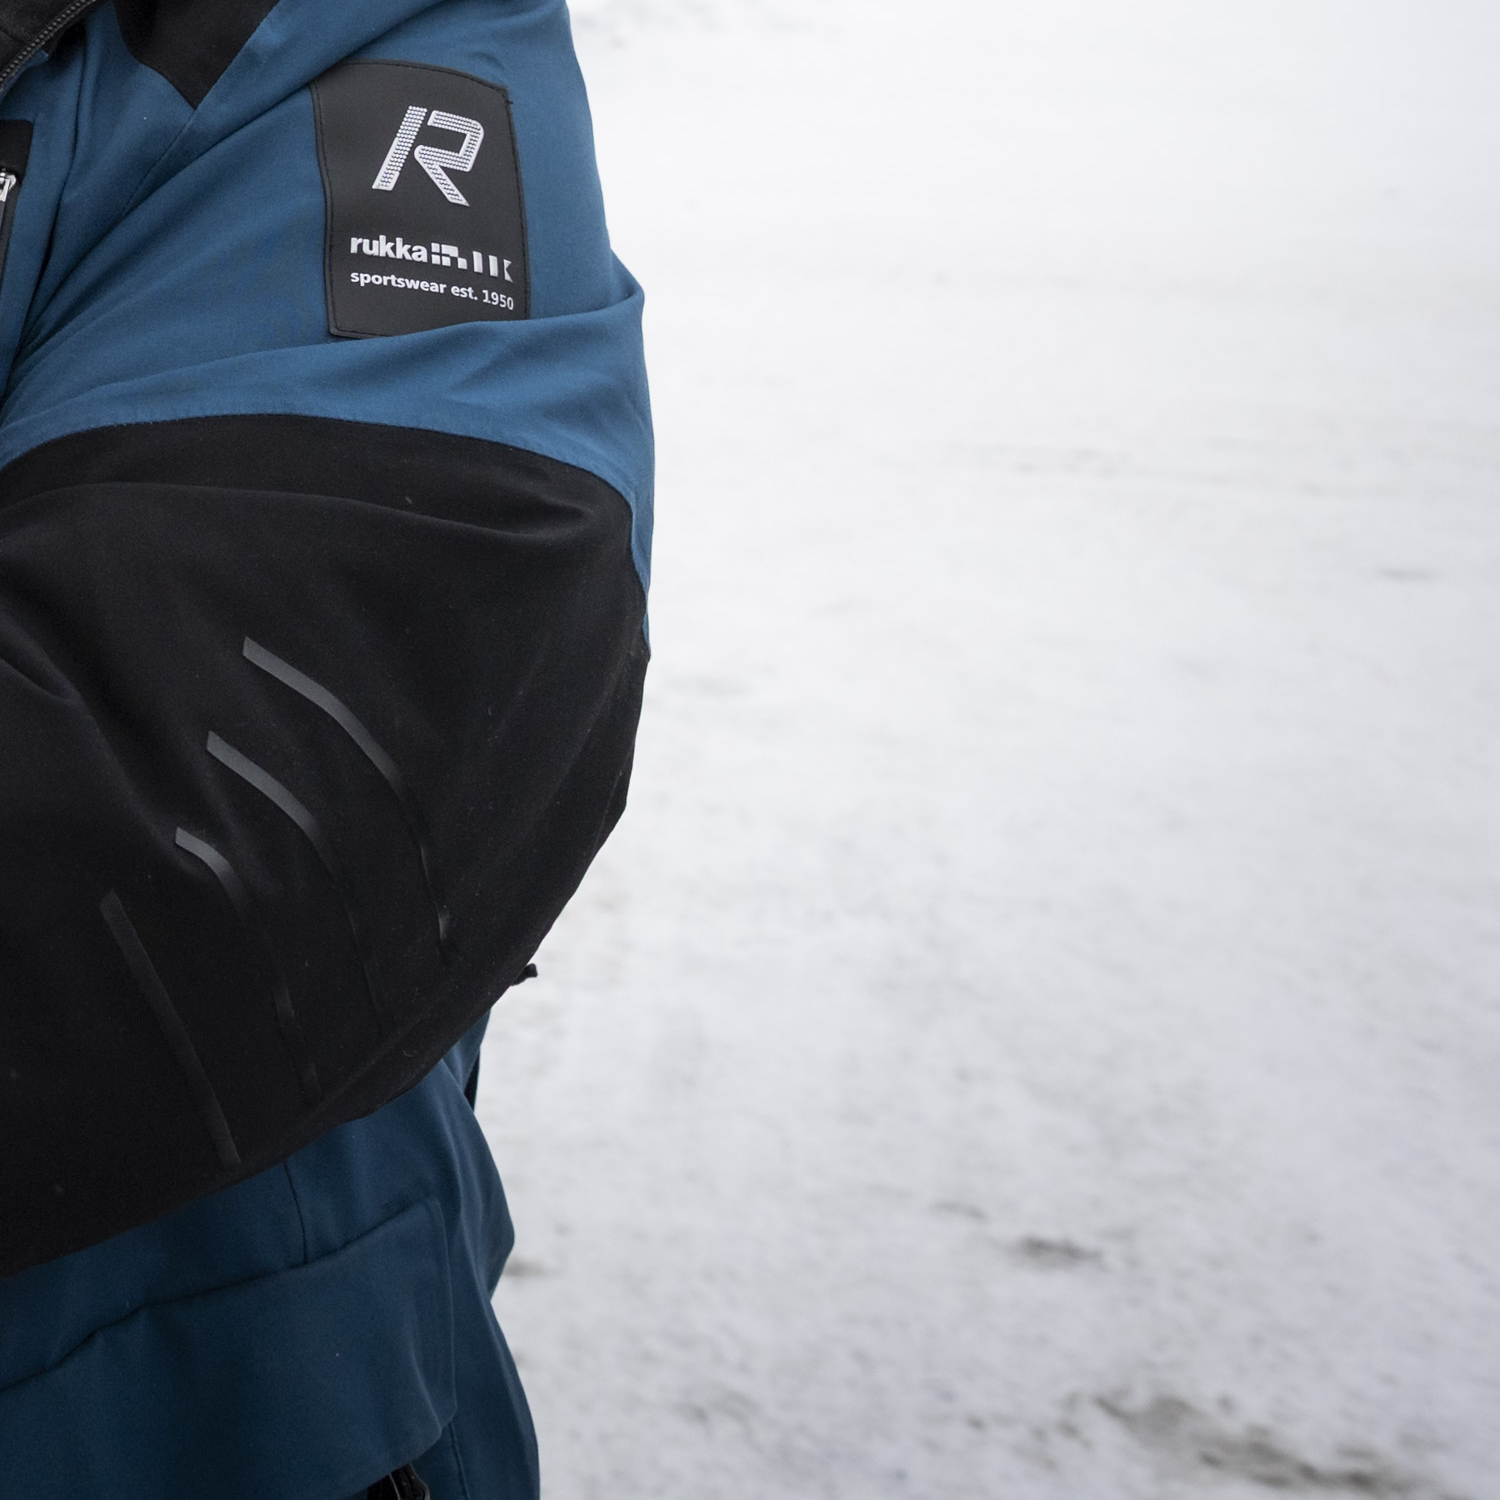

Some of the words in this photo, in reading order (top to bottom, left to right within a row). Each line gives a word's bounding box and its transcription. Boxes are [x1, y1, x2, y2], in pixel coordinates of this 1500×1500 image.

[372, 105, 484, 206] R
[350, 234, 428, 264] rukka
[350, 271, 447, 295] sportswear
[450, 284, 478, 301] est.
[481, 289, 515, 311] 1950
